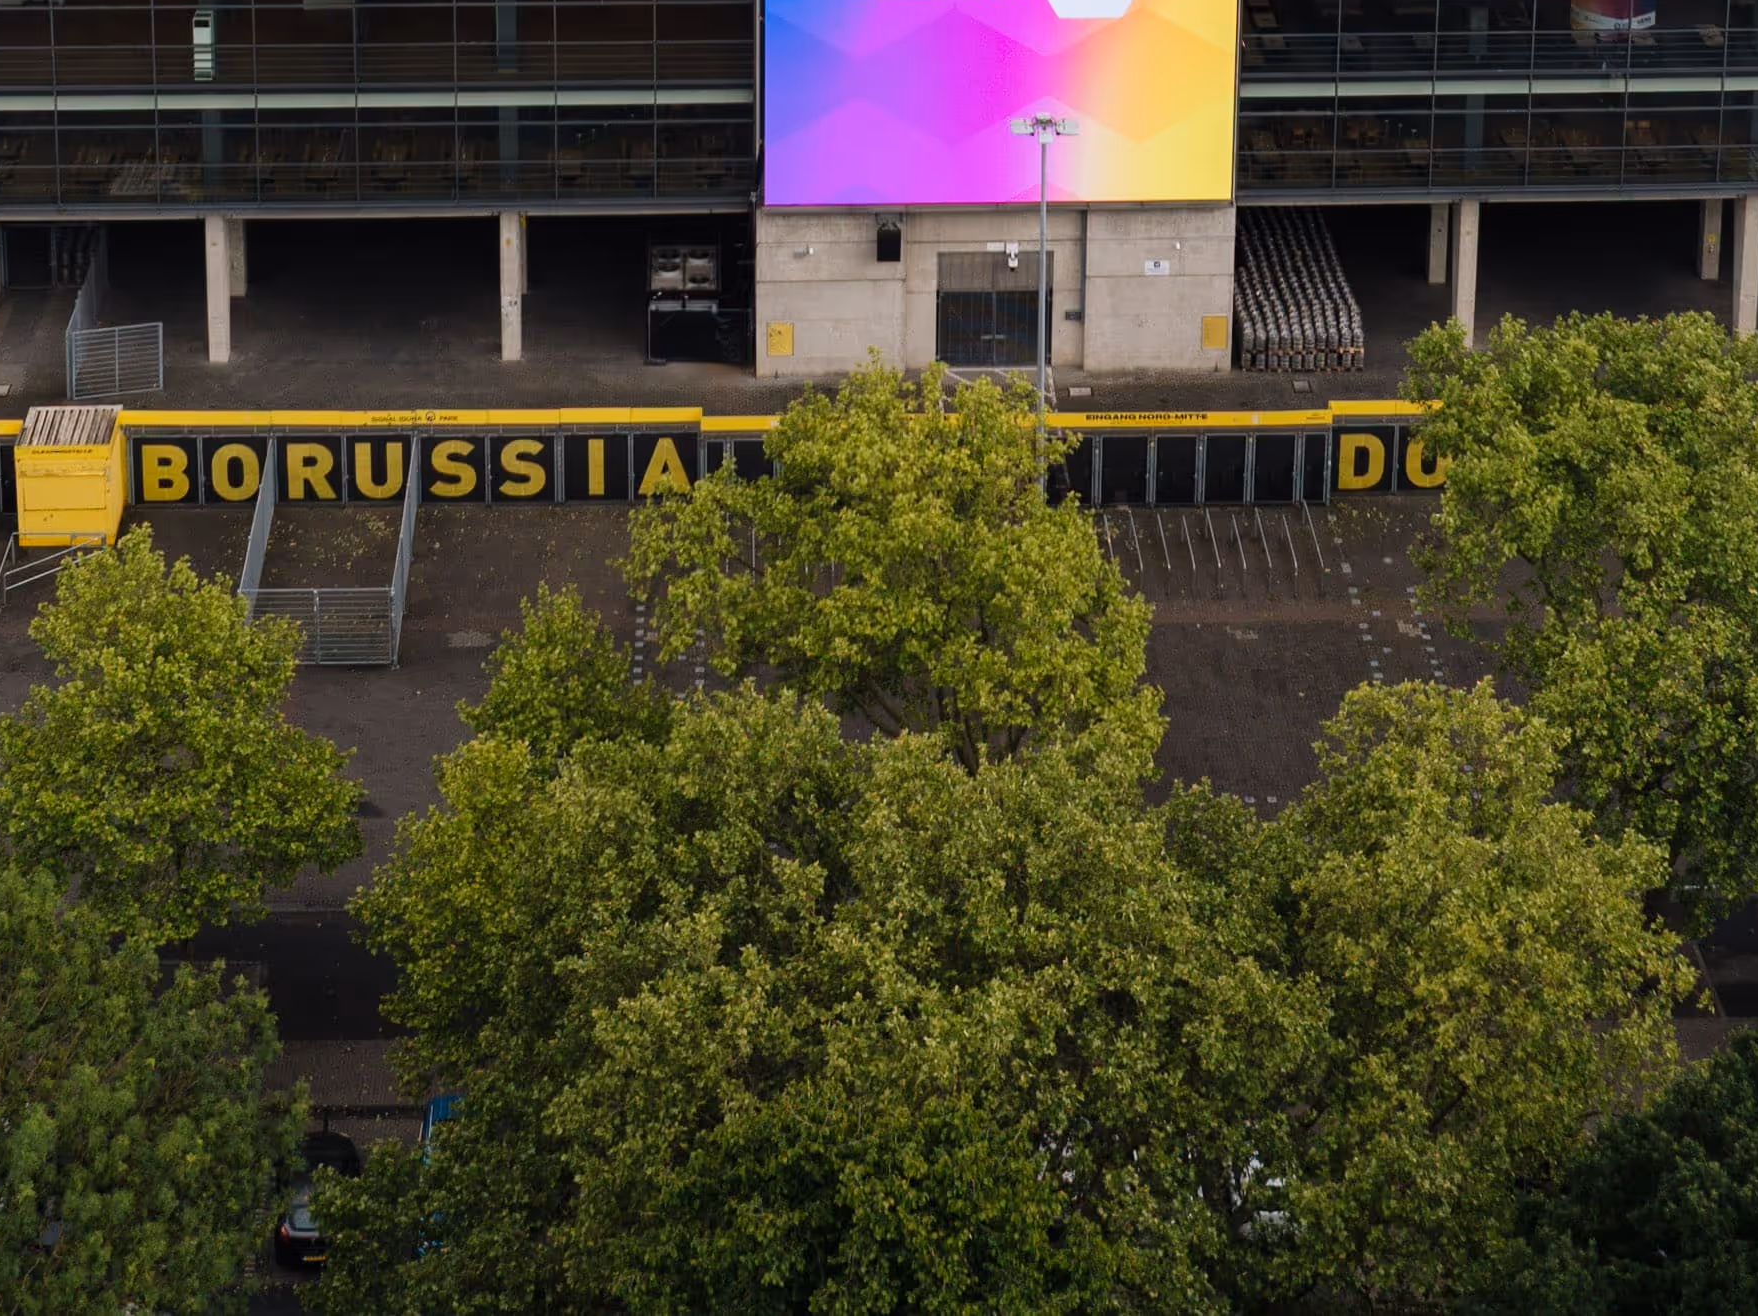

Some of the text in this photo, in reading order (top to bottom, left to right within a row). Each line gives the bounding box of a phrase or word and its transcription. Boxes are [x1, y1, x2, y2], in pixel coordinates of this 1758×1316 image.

[1085, 413, 1208, 421] EINGANG NORD-MITTE
[143, 437, 691, 502] BORUSSIA
